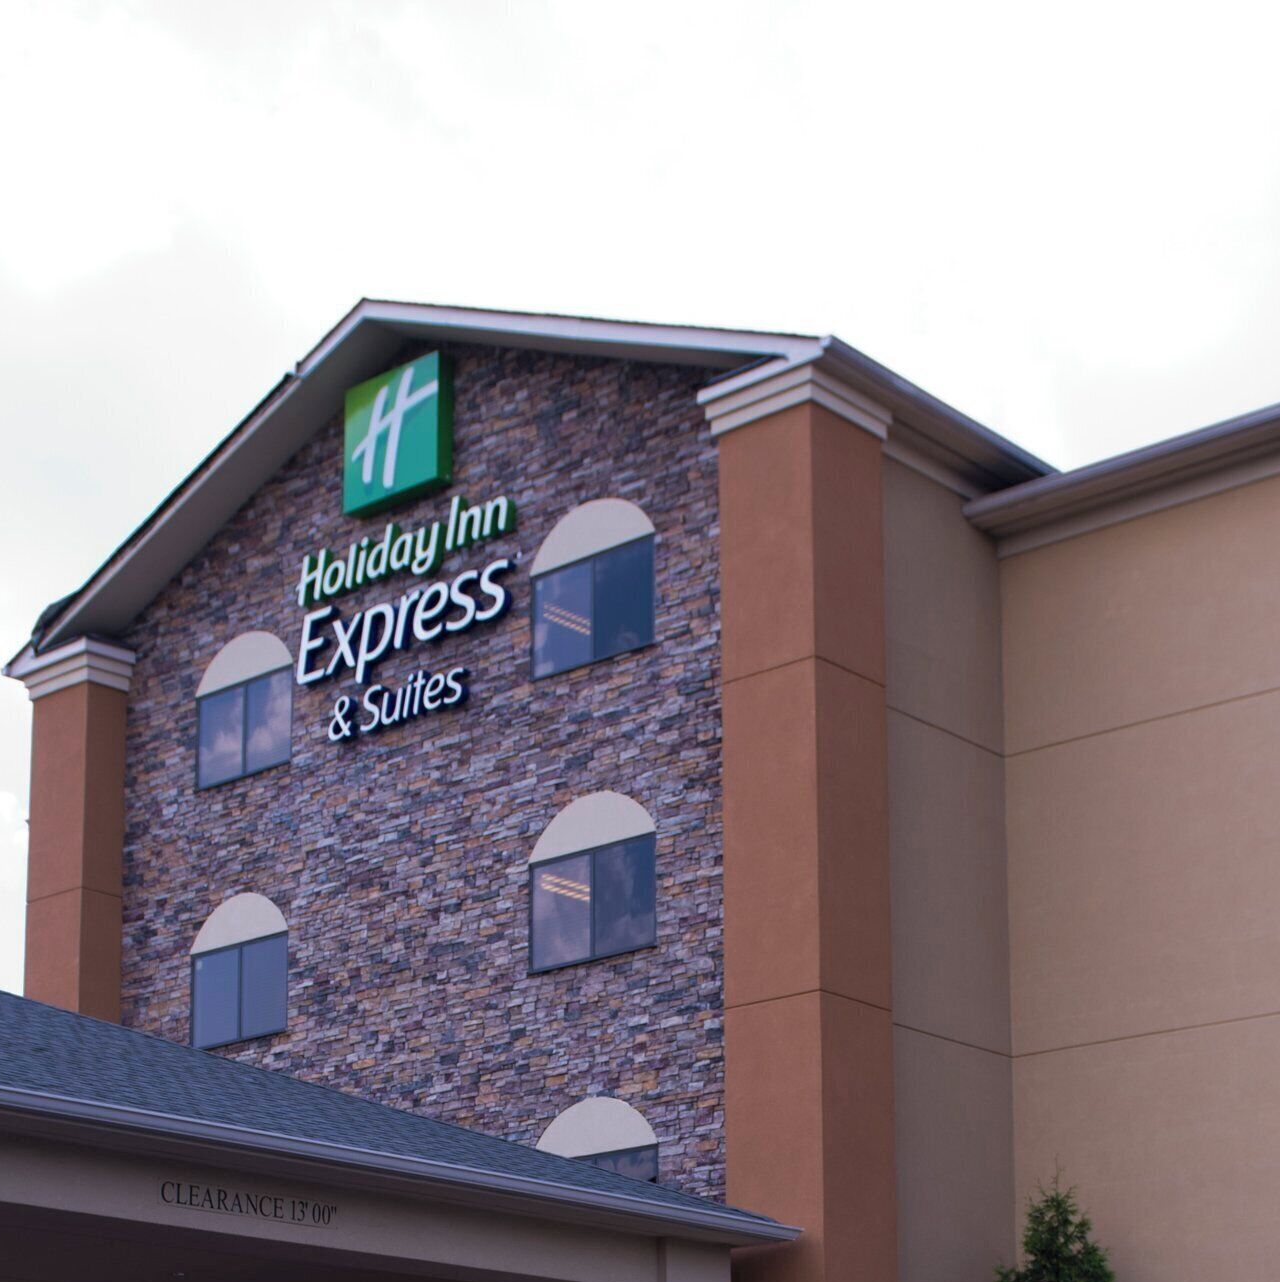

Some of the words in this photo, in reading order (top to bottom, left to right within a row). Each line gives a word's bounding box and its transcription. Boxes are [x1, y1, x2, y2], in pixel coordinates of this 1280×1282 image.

[296, 522, 441, 608] Holiday
[445, 495, 509, 551] Inn
[296, 558, 509, 686] Express
[327, 695, 352, 742] &
[360, 667, 465, 732] Suites
[160, 1180, 285, 1220] CLEARANCE
[290, 1199, 309, 1222] 13'
